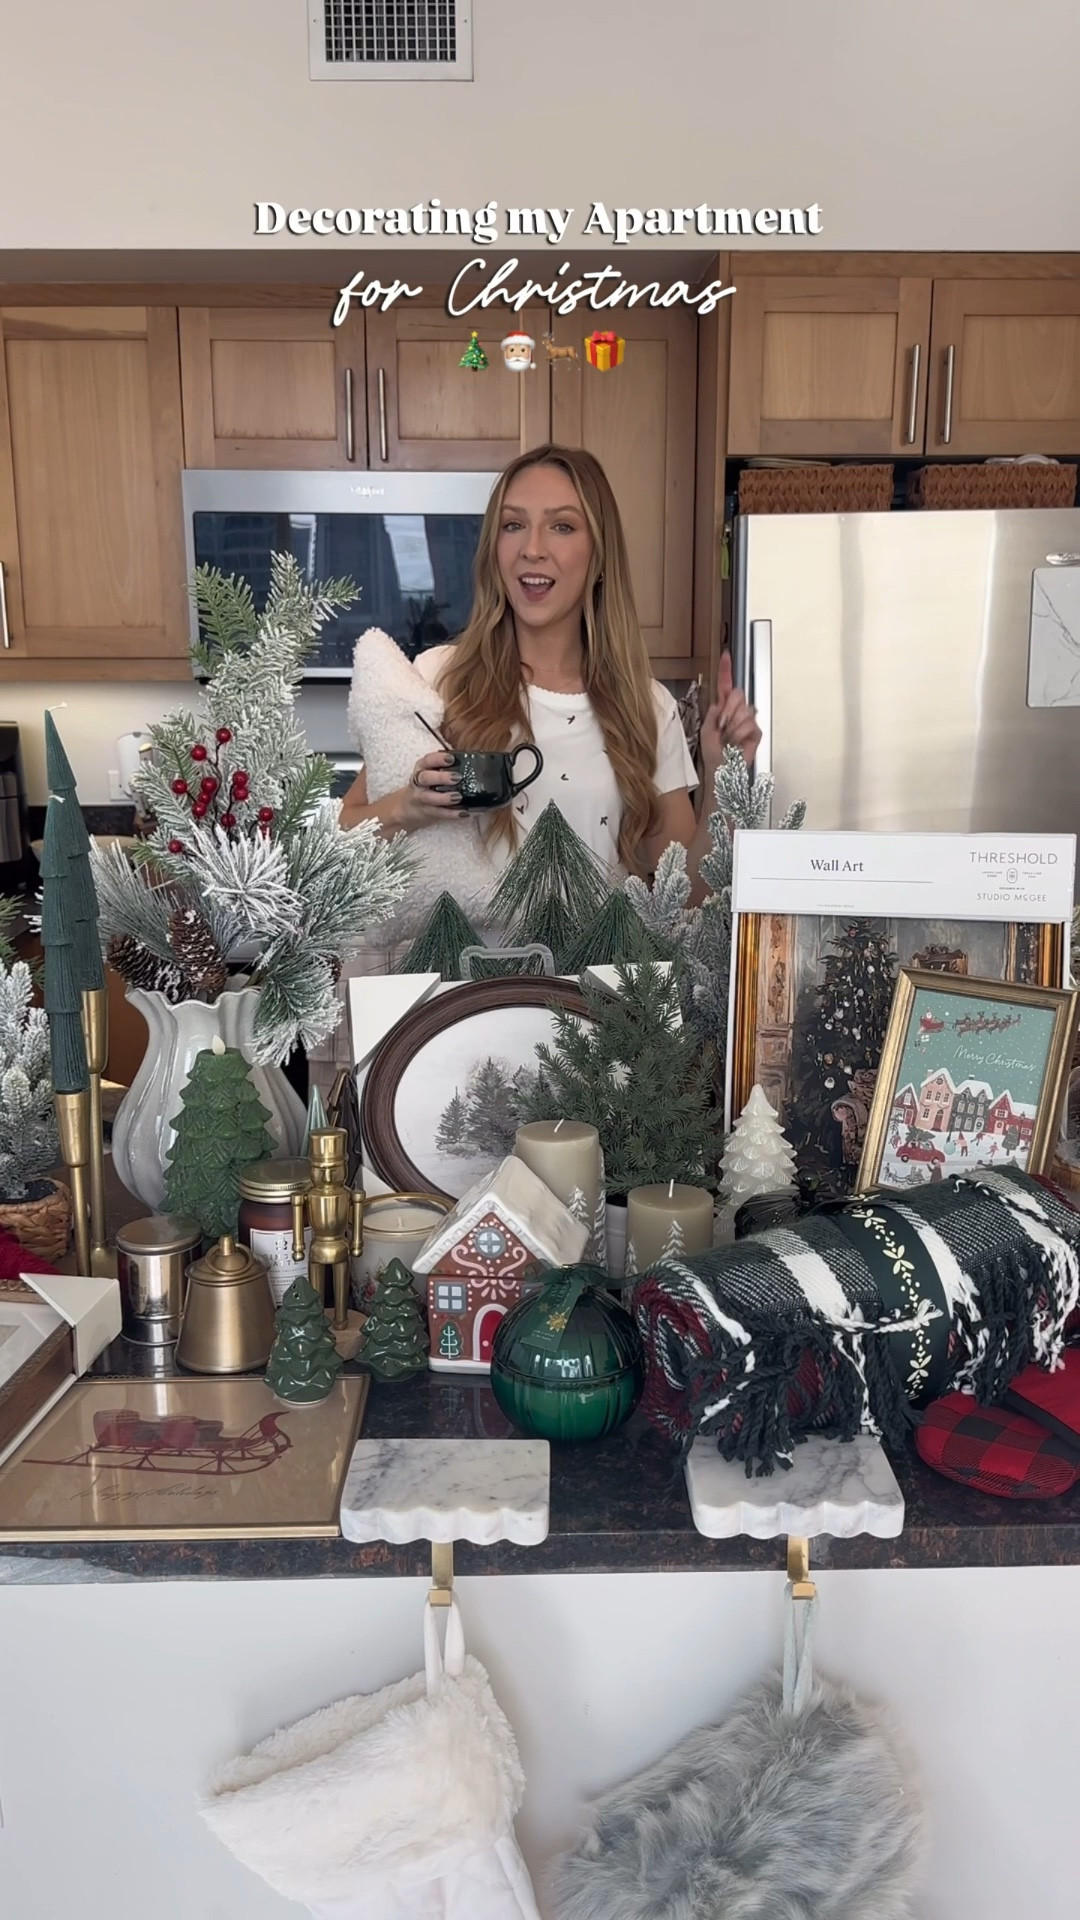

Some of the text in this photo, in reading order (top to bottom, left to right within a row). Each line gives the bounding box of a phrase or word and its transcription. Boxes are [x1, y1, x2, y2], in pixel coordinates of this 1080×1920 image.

[969, 851, 1058, 865] THRESHOLD
[810, 859, 865, 872] Wall Art
[976, 892, 1011, 901] STUDIO
[953, 1044, 1037, 1072] Merry Christmas
